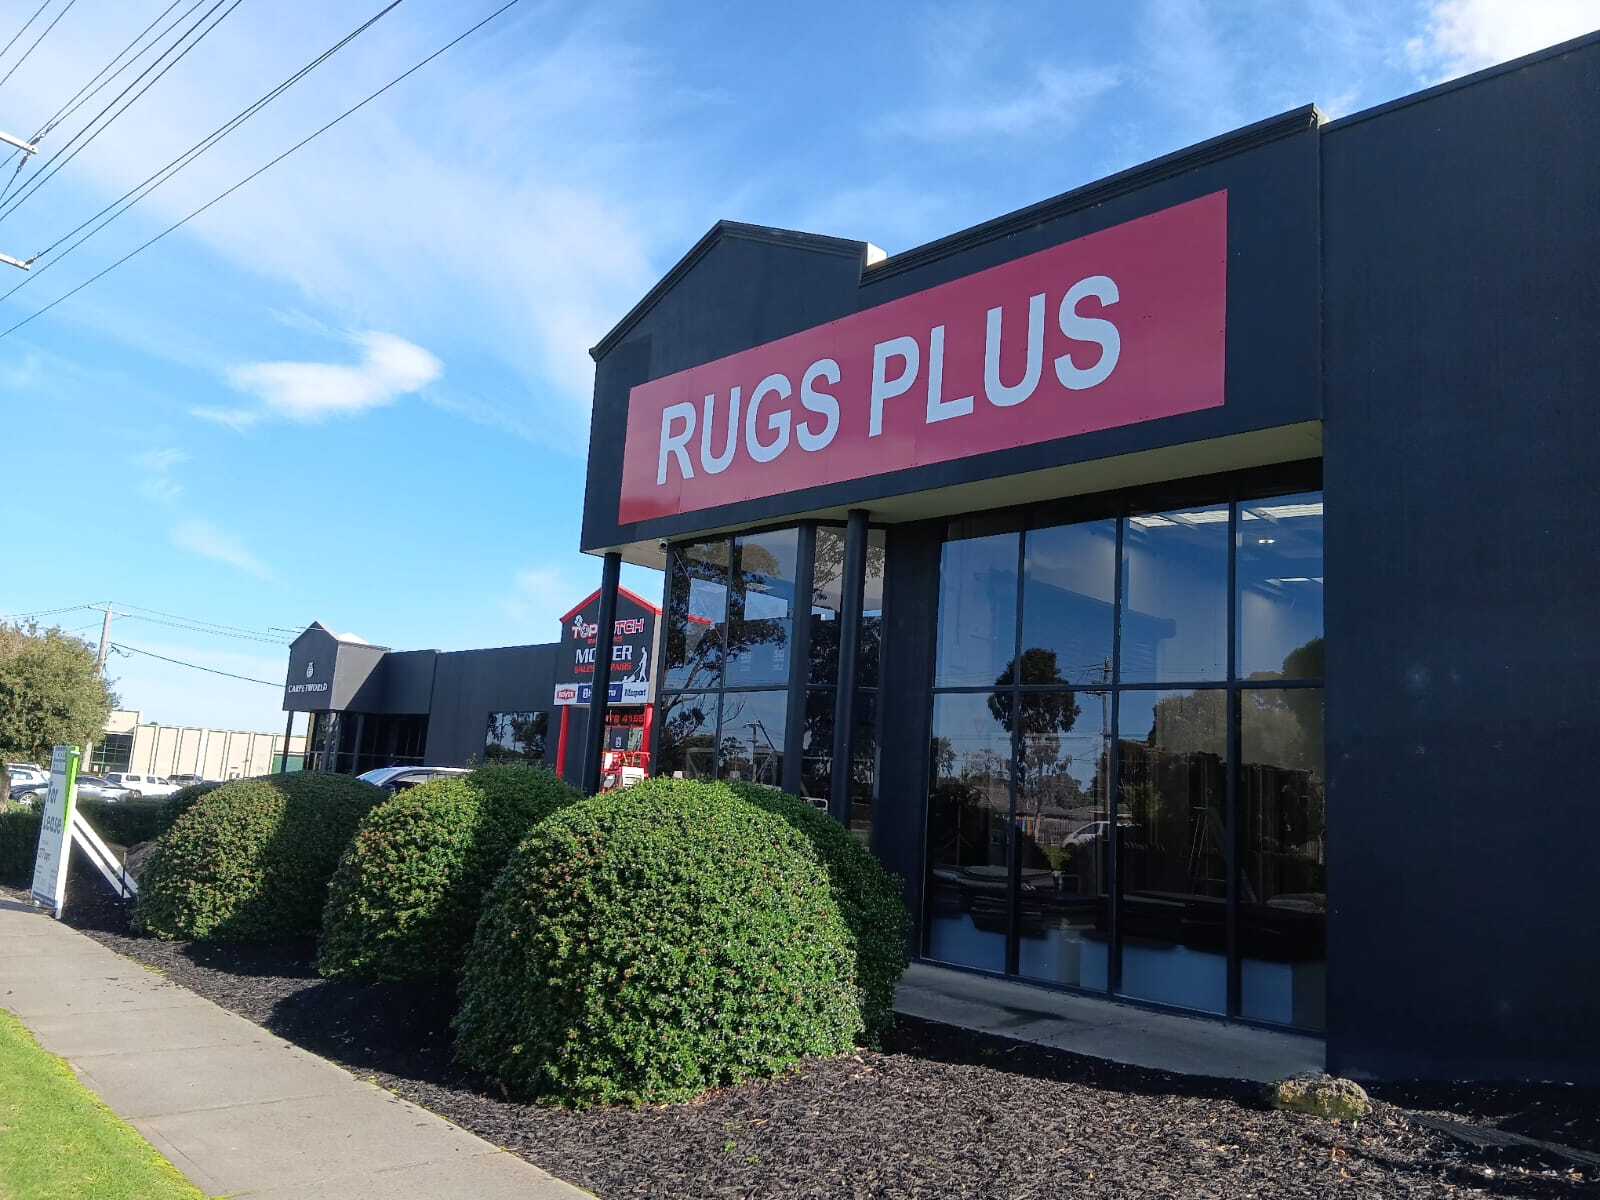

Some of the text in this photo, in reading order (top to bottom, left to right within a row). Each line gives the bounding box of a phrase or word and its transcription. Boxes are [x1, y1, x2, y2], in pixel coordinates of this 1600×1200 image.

[655, 275, 1121, 485] RUGS PLUS
[575, 645, 633, 664] MOER
